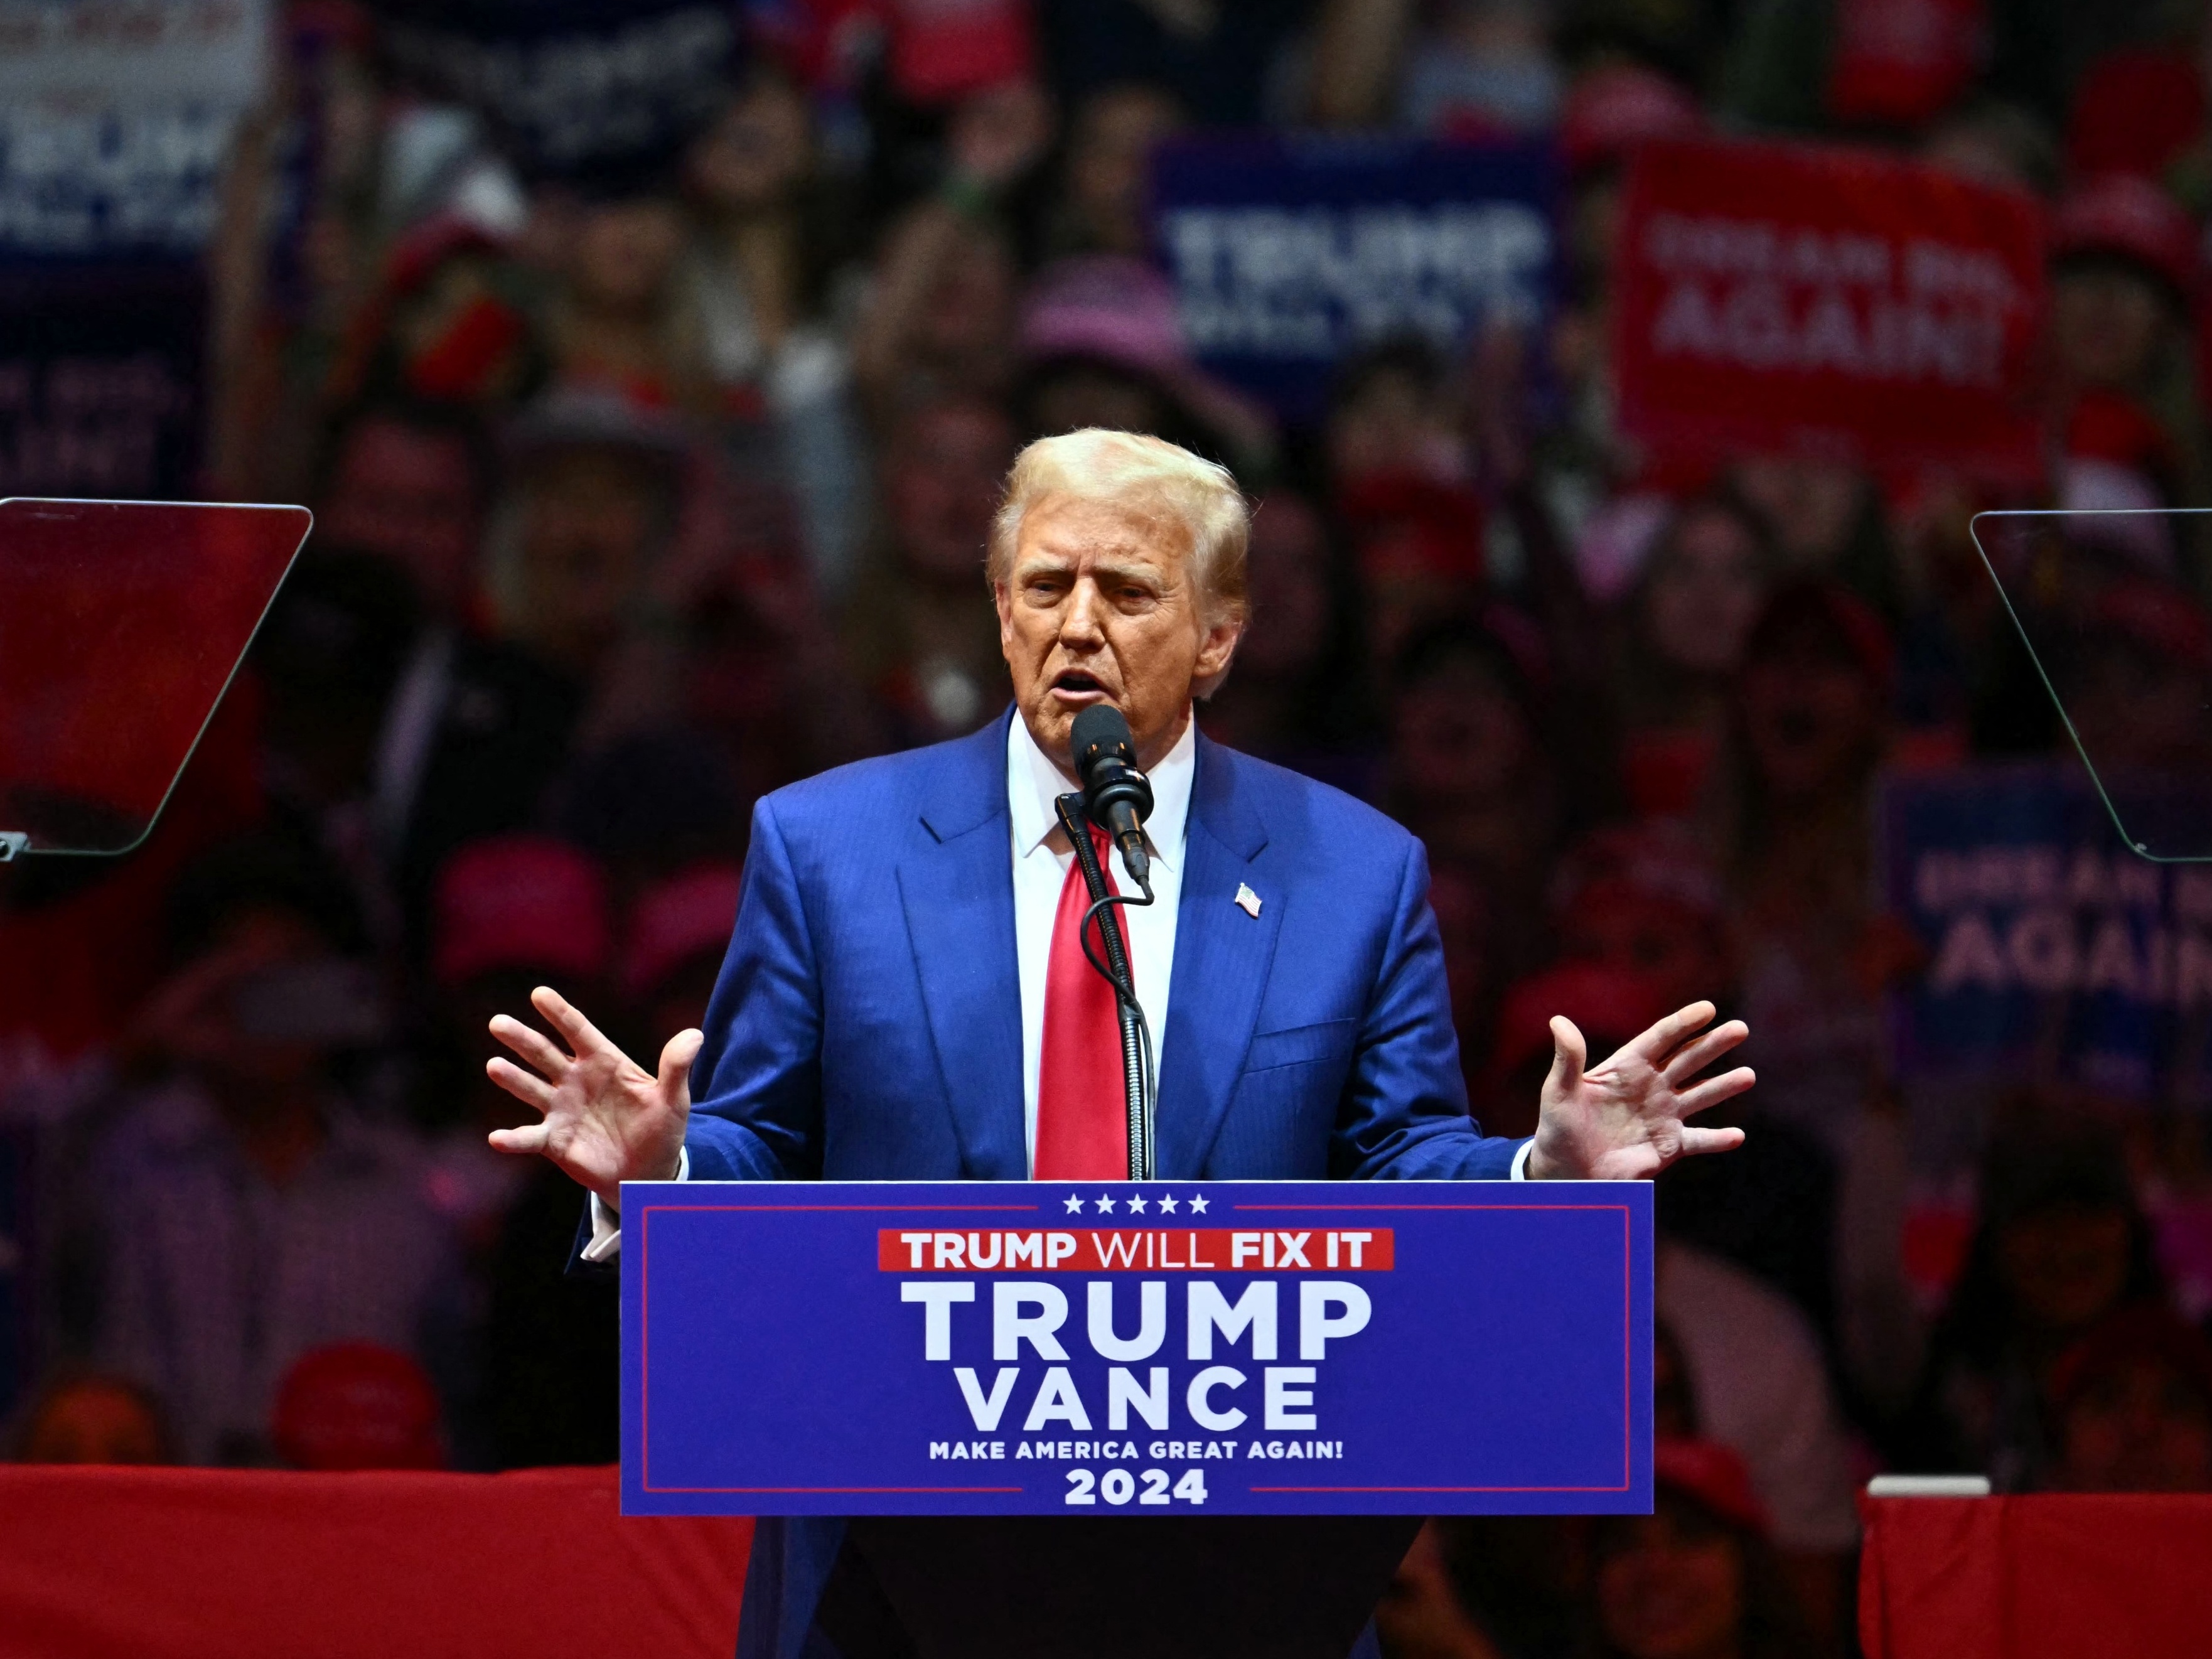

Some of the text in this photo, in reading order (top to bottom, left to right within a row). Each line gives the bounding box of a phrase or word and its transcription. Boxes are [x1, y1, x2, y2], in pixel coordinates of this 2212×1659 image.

[900, 1232, 1372, 1269] TRUMP WILL FIX IT
[900, 1280, 1372, 1361] TRUMP
[953, 1366, 1317, 1432] VANCE
[930, 1441, 1343, 1459] MAKE AMERICA GREAT AGAIN!
[1065, 1468, 1208, 1505] 2024
